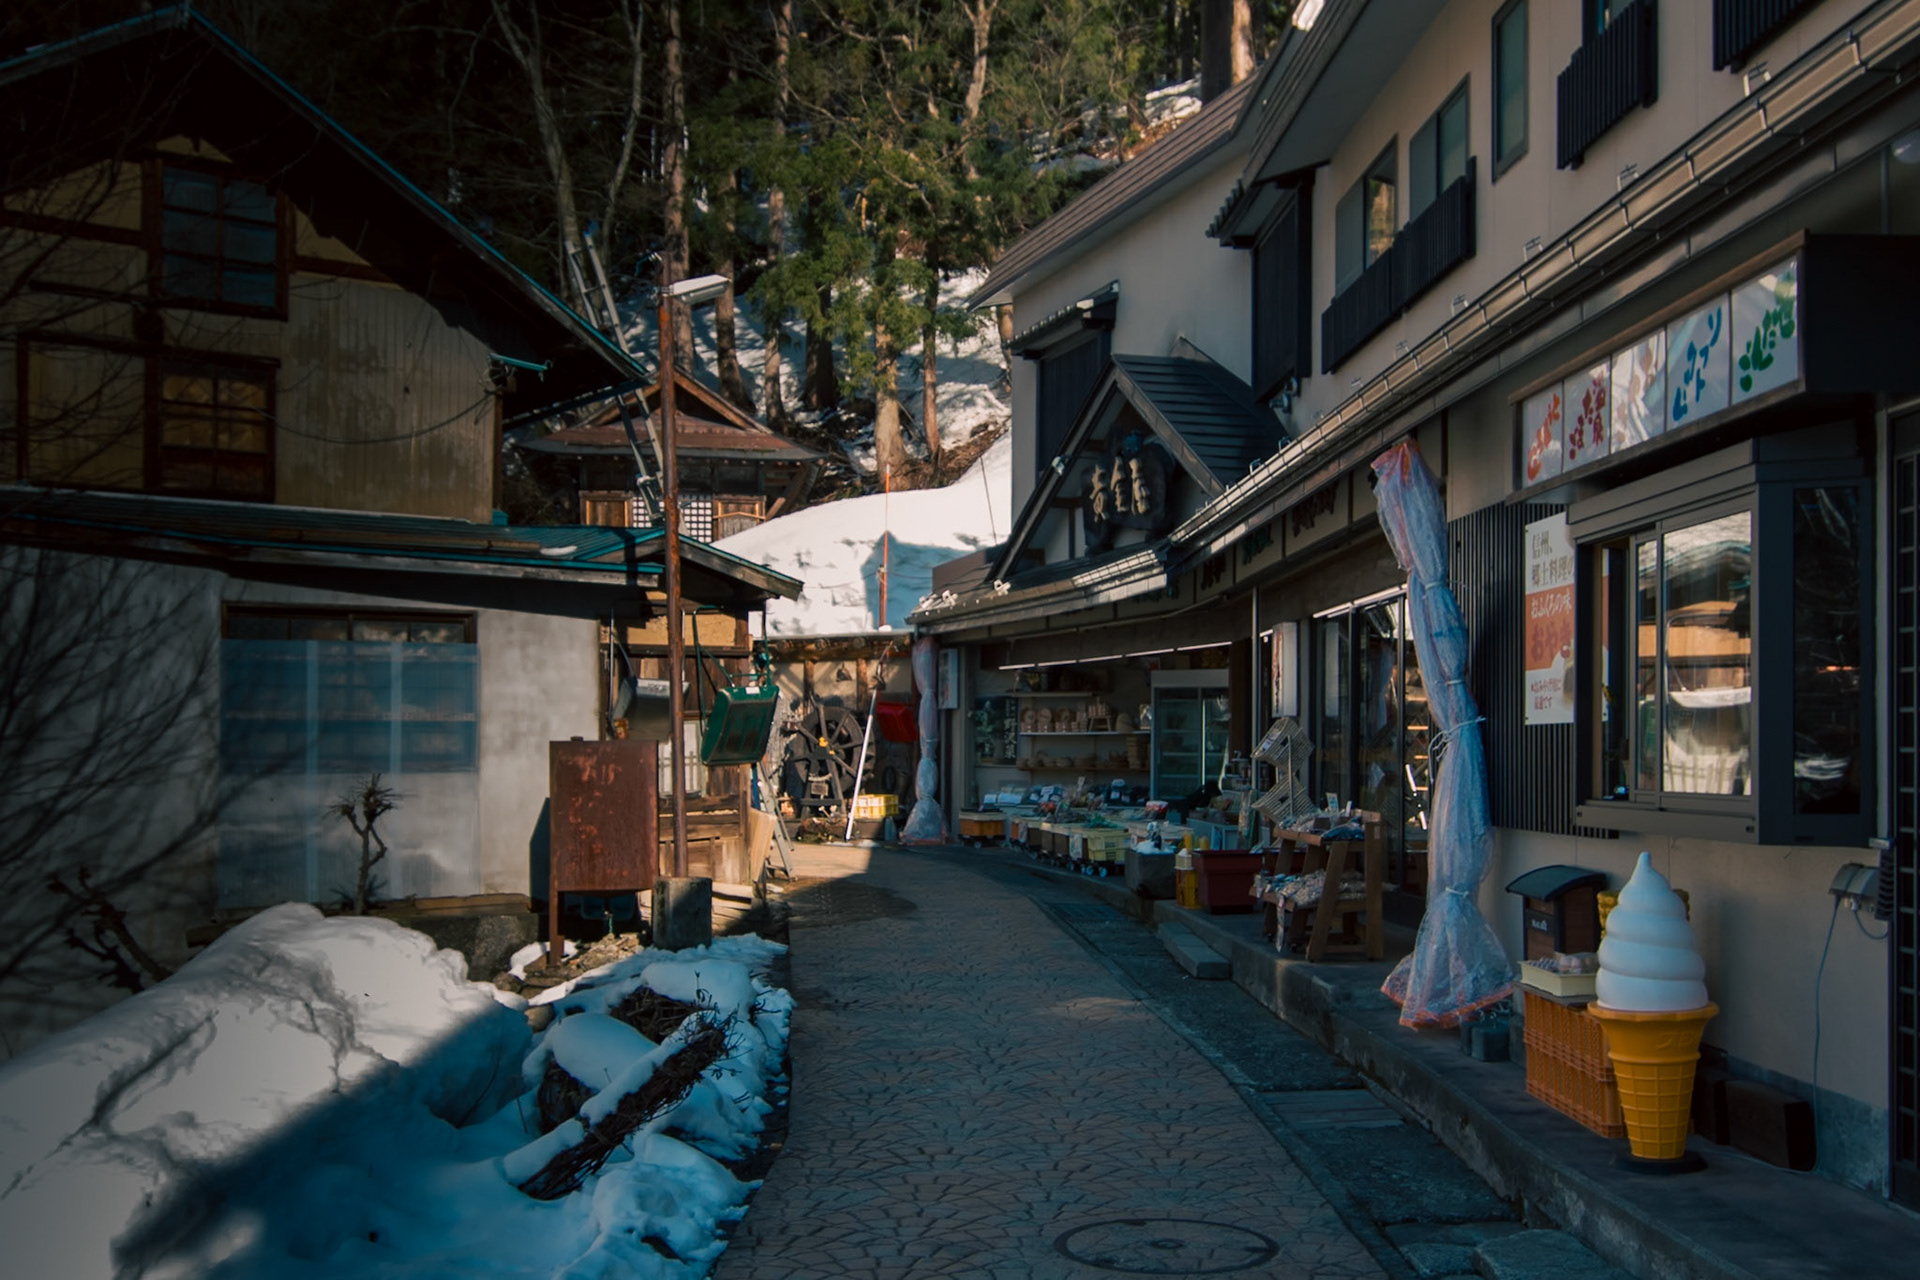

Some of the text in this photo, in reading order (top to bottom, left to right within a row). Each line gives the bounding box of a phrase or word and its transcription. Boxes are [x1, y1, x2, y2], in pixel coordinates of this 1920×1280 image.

[1531, 590, 1572, 620] おふくろの味
